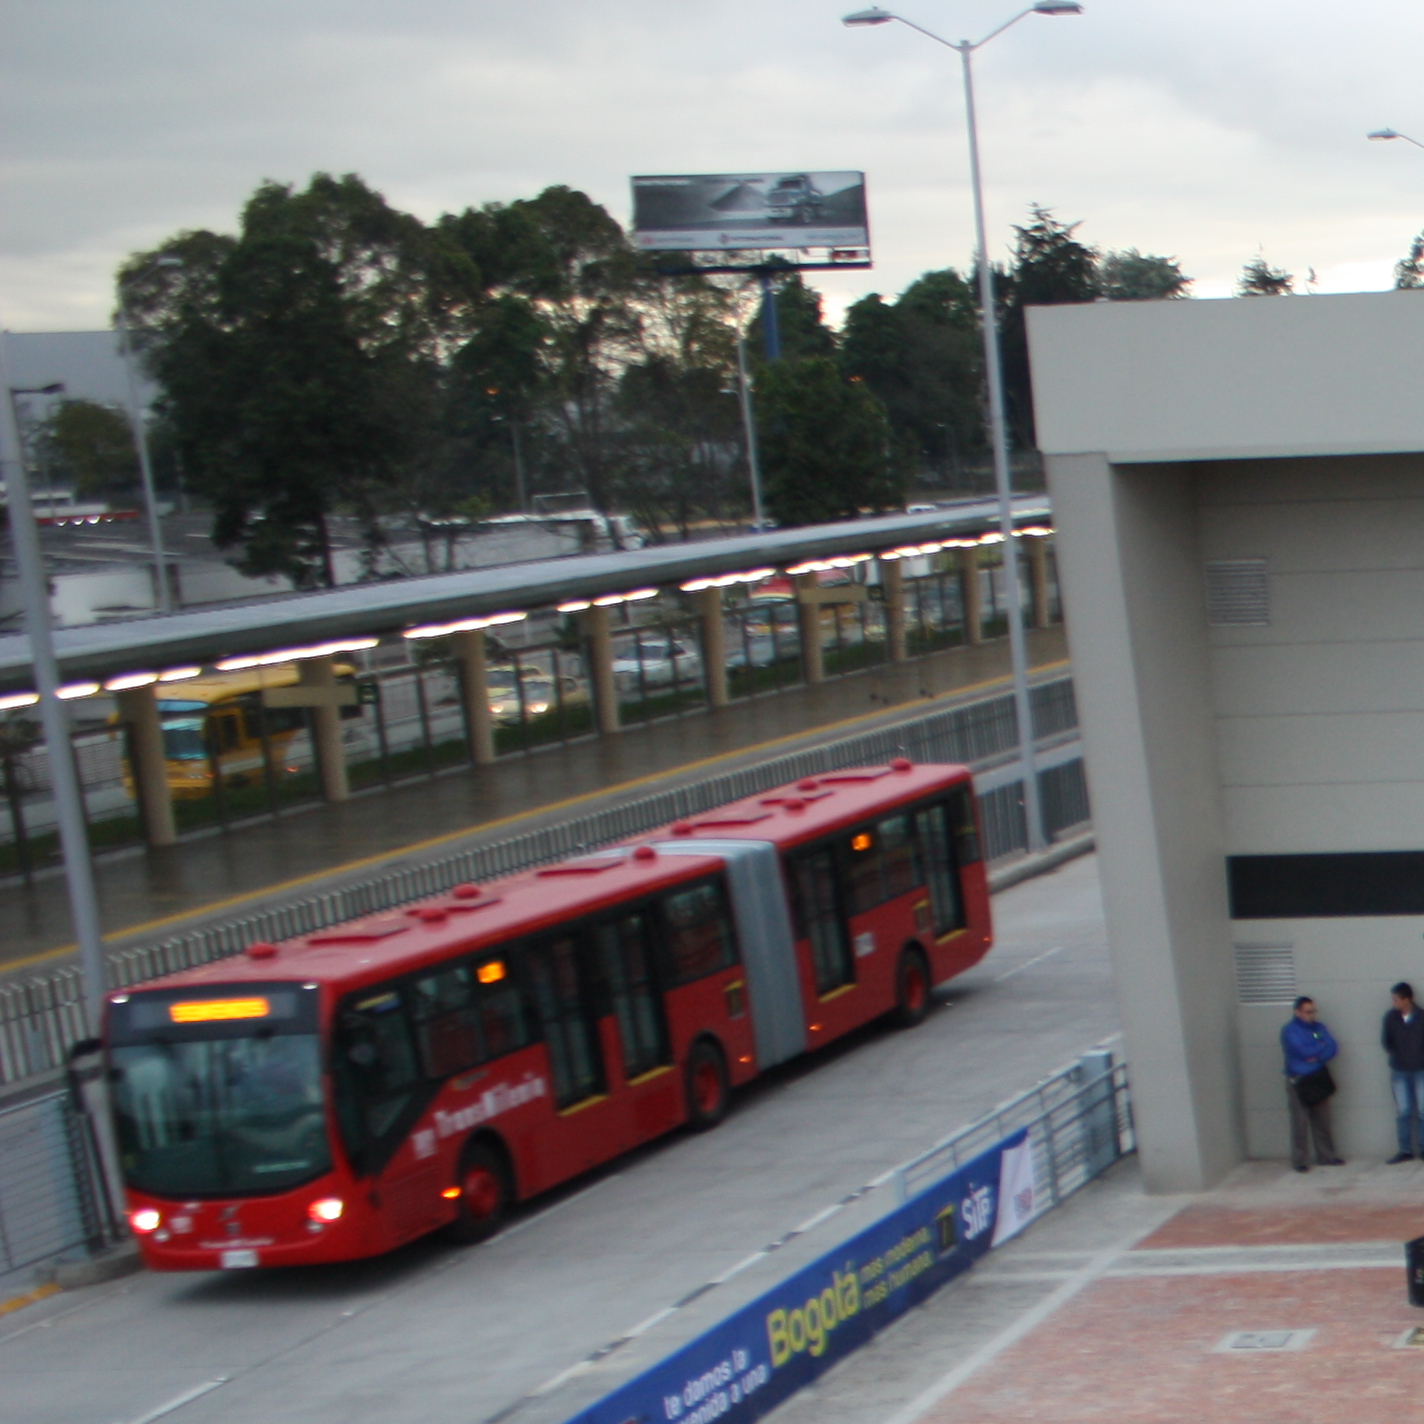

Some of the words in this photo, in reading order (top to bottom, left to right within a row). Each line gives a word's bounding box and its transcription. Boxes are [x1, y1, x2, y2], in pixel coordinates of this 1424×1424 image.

[766, 1259, 860, 1368] Bogotá
[664, 1395, 681, 1420] te
[683, 1360, 732, 1408] damos
[732, 1349, 749, 1372] la
[729, 1382, 741, 1404] a
[742, 1363, 769, 1395] una
